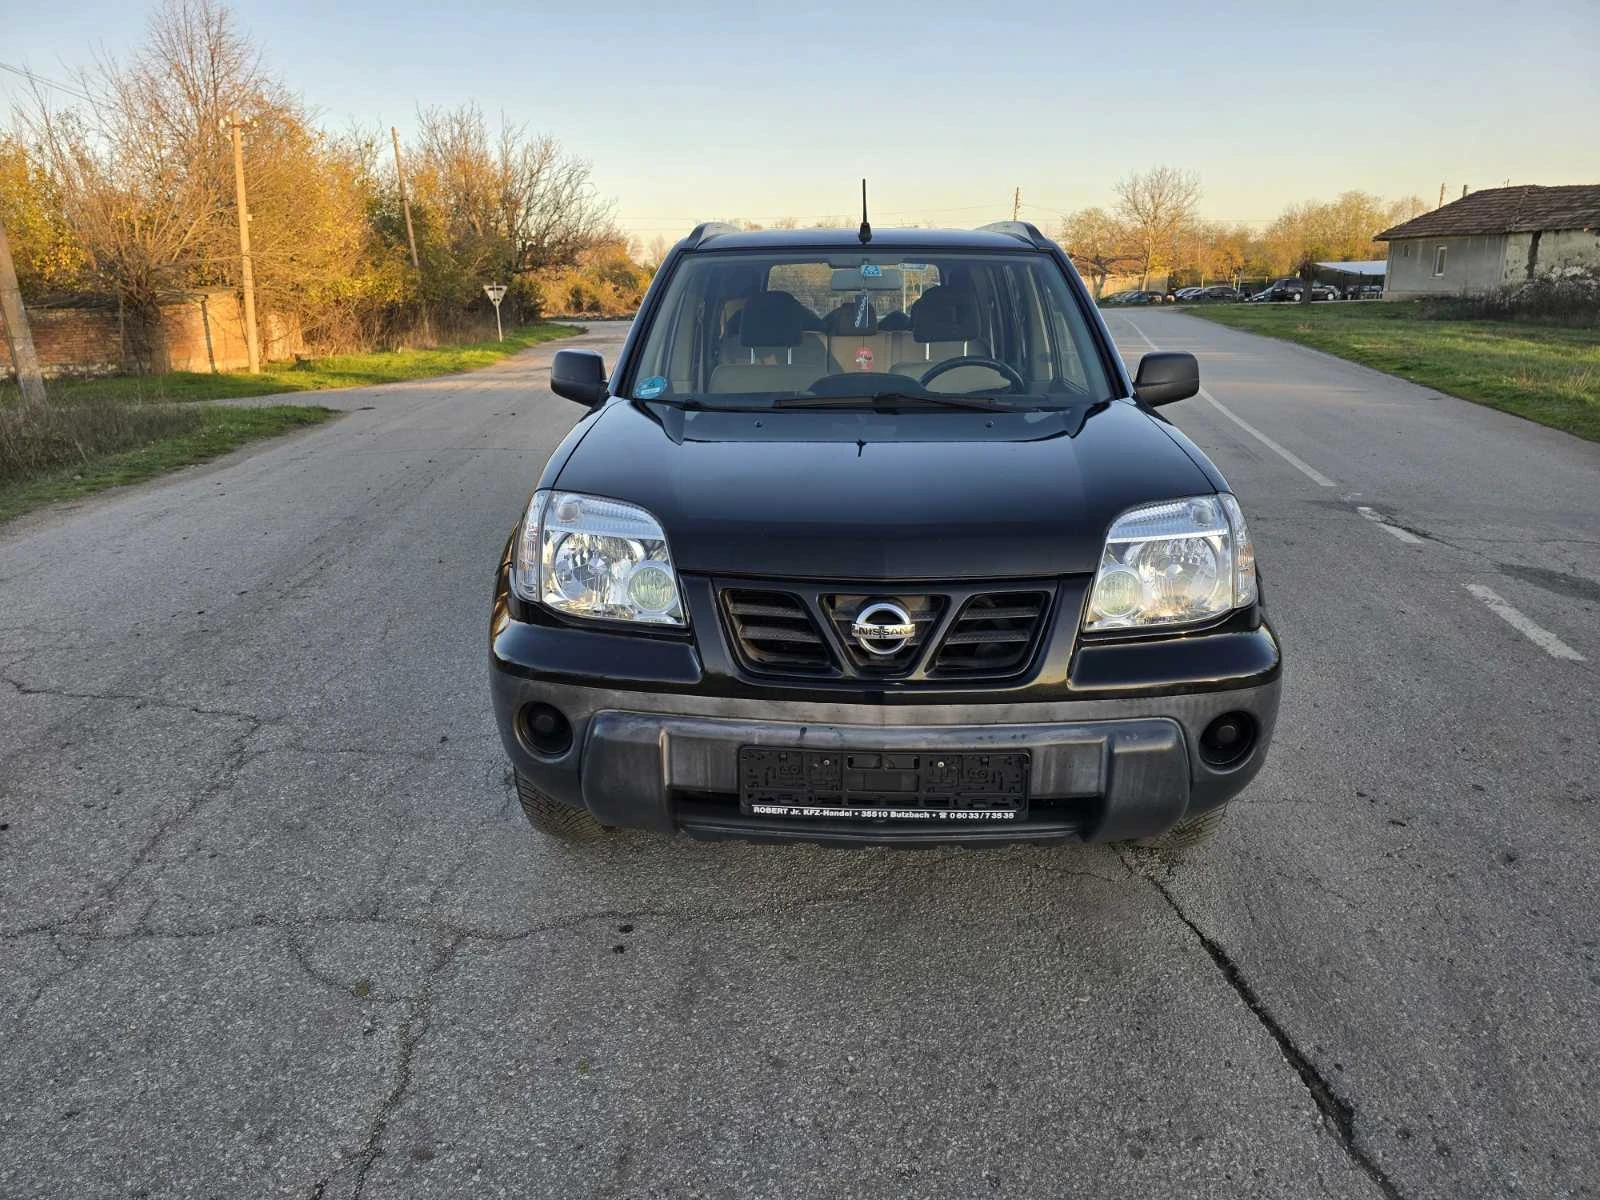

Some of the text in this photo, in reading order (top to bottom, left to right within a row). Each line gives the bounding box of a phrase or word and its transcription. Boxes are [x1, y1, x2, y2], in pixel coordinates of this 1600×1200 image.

[858, 627, 907, 636] NISSAN
[753, 806, 788, 815] ROBERT
[790, 808, 801, 816] Jr.
[803, 808, 852, 817] KFZ-Handel
[890, 811, 930, 819] Butzbach
